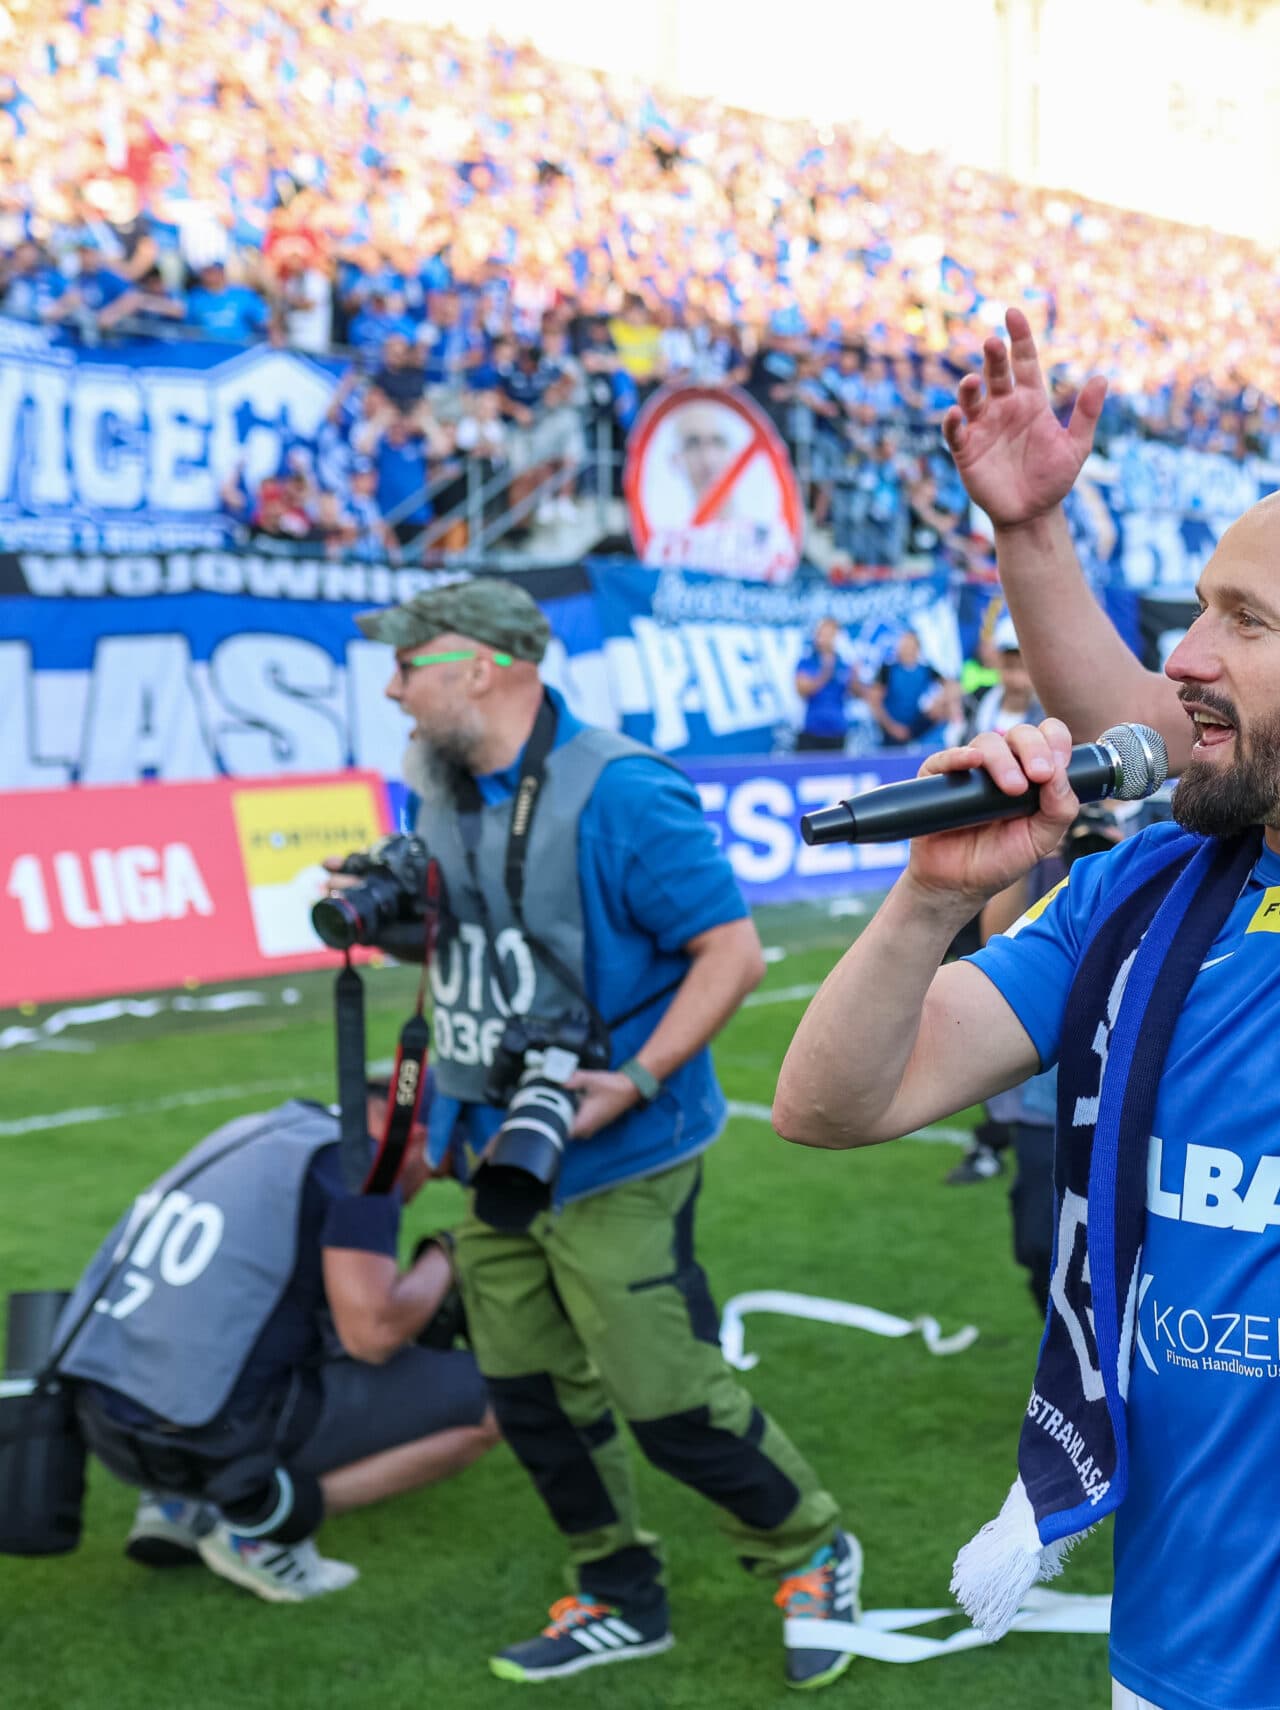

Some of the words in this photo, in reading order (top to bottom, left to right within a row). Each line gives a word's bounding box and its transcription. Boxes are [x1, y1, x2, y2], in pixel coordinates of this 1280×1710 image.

[18, 553, 474, 602] WOJOWNIC
[8, 855, 52, 933] 1
[54, 843, 213, 930] LIGA
[1166, 1349, 1200, 1370] Firma
[1202, 1356, 1264, 1378] Handlowo
[1027, 1384, 1111, 1506] STRAKLASA
